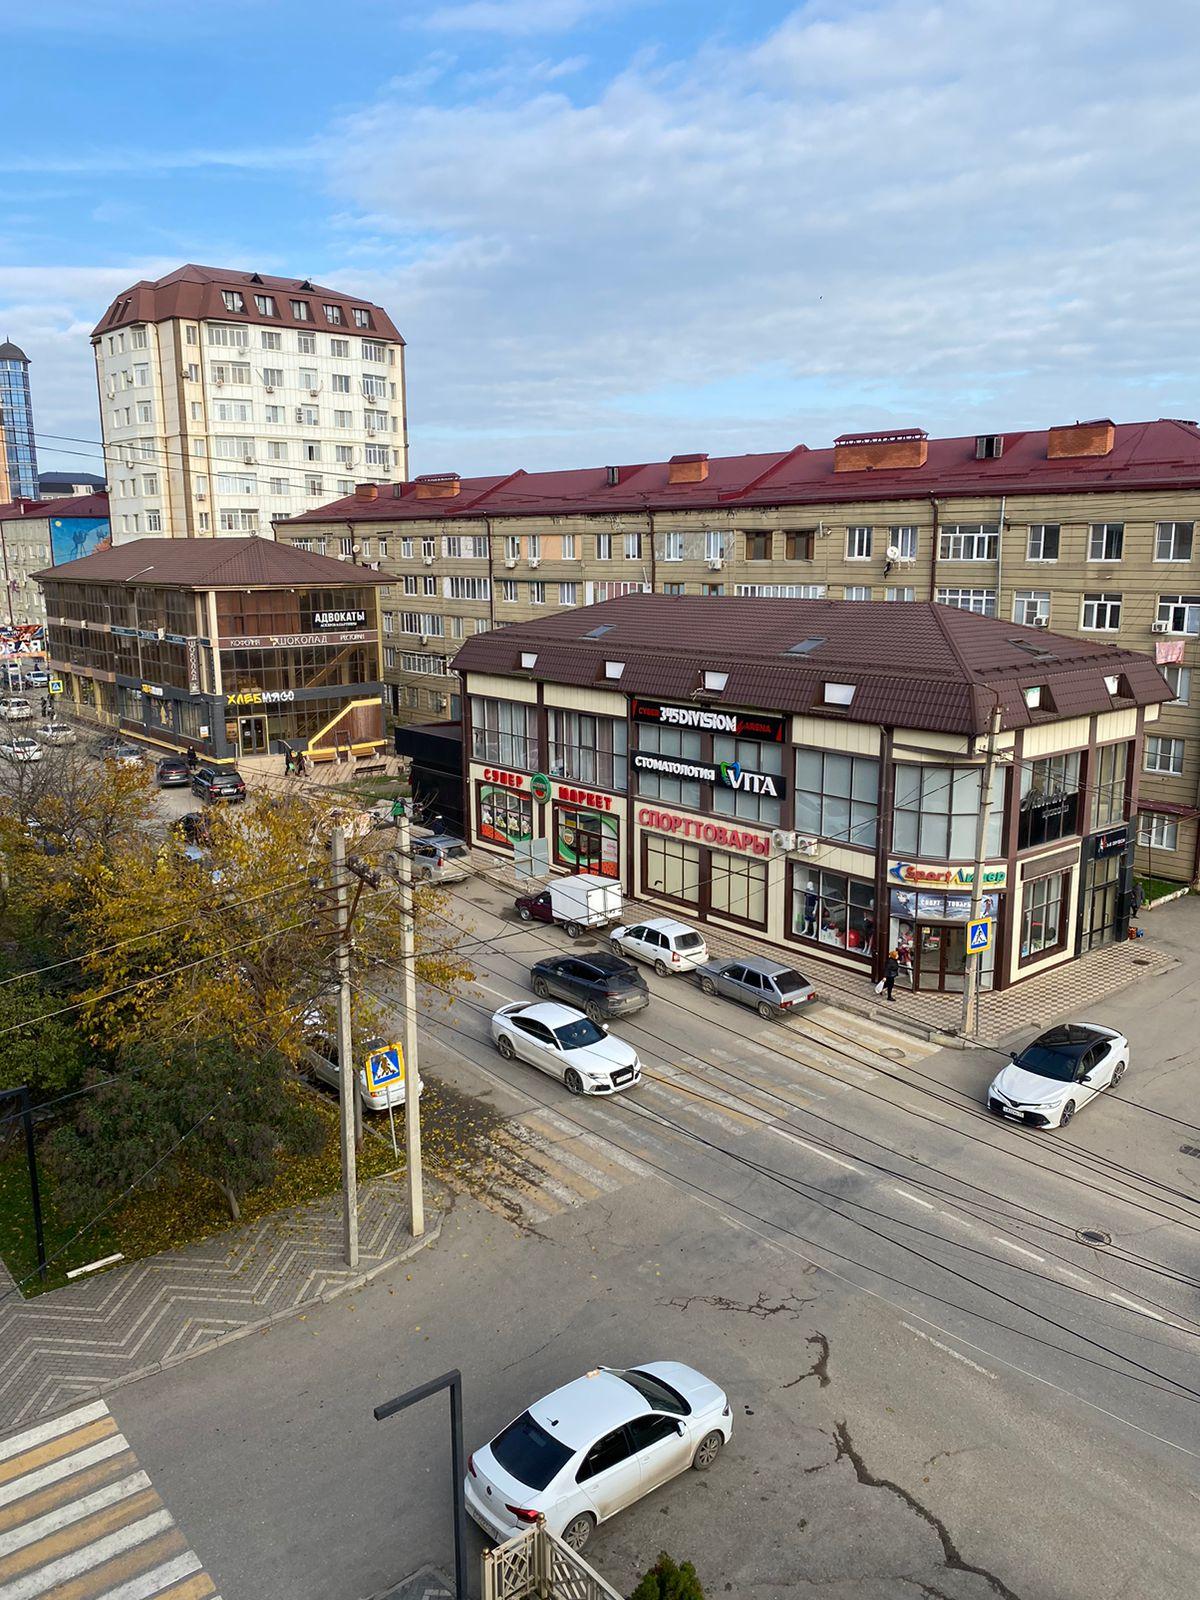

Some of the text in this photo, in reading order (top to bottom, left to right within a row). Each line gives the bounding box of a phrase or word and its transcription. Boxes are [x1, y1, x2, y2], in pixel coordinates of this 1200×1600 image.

[314, 611, 365, 624] АДВОКАТЫ
[279, 635, 329, 646] ШОКОЛАД
[483, 768, 613, 811] СУПЕР МАРКЕТ
[635, 756, 778, 797] СТОМАТОЛОГИЯ VITA
[638, 808, 770, 857] СПОРТТОВАРЫ
[951, 868, 1006, 885] Лиер
